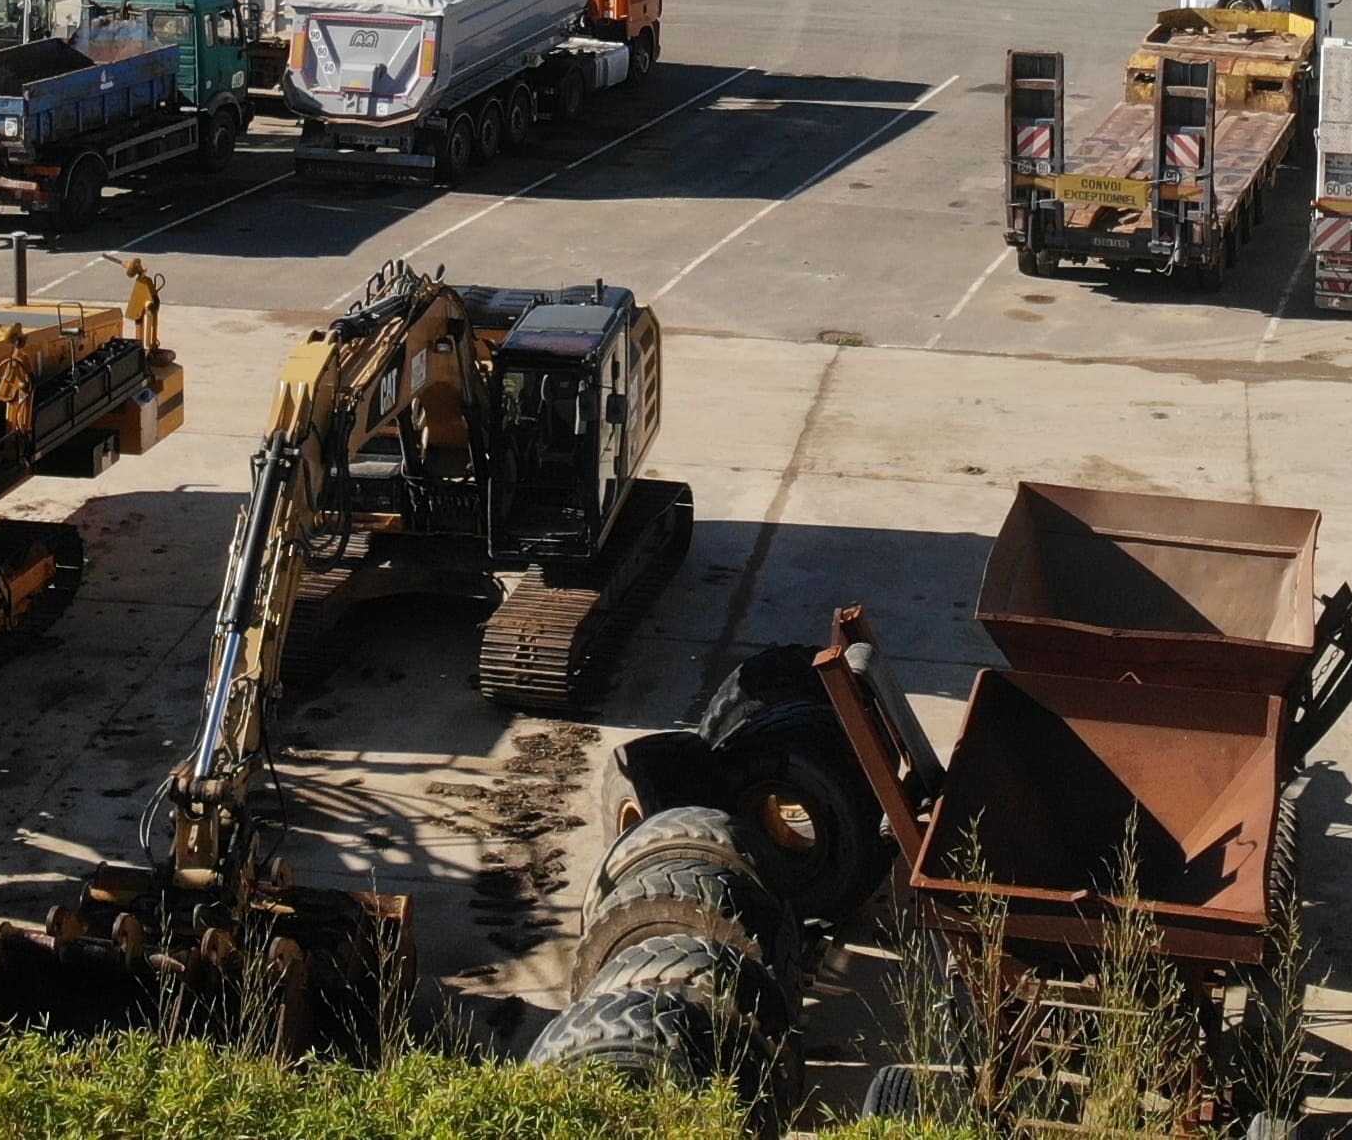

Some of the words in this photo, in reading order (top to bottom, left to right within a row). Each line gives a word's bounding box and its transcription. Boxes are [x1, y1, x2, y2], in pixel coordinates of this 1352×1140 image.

[1080, 178, 1122, 192] CONVOI
[1326, 183, 1341, 196] 60
[1063, 189, 1137, 206] EXCEPTIONNEL
[380, 367, 398, 416] CAT
